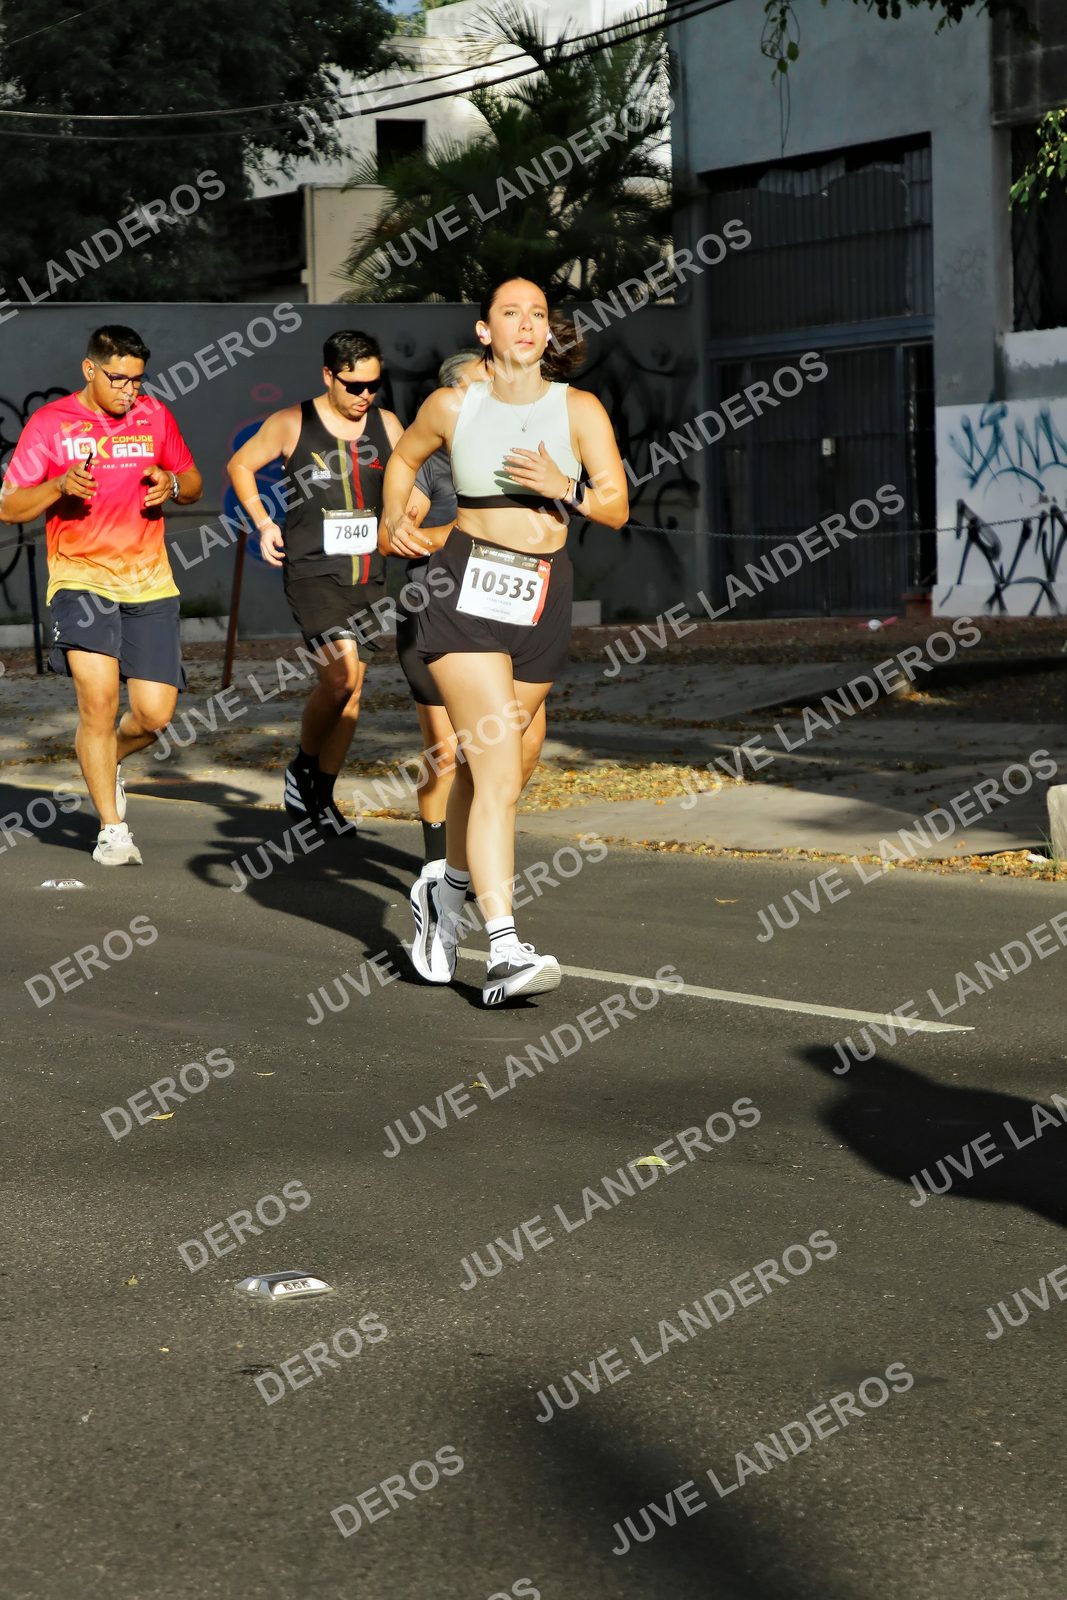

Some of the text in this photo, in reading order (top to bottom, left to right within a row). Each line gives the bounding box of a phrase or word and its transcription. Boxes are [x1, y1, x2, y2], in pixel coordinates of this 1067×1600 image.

[111, 435, 153, 443] COMUDE
[112, 443, 154, 458] GDL
[335, 524, 368, 540] 7840
[471, 567, 537, 601] 10535
